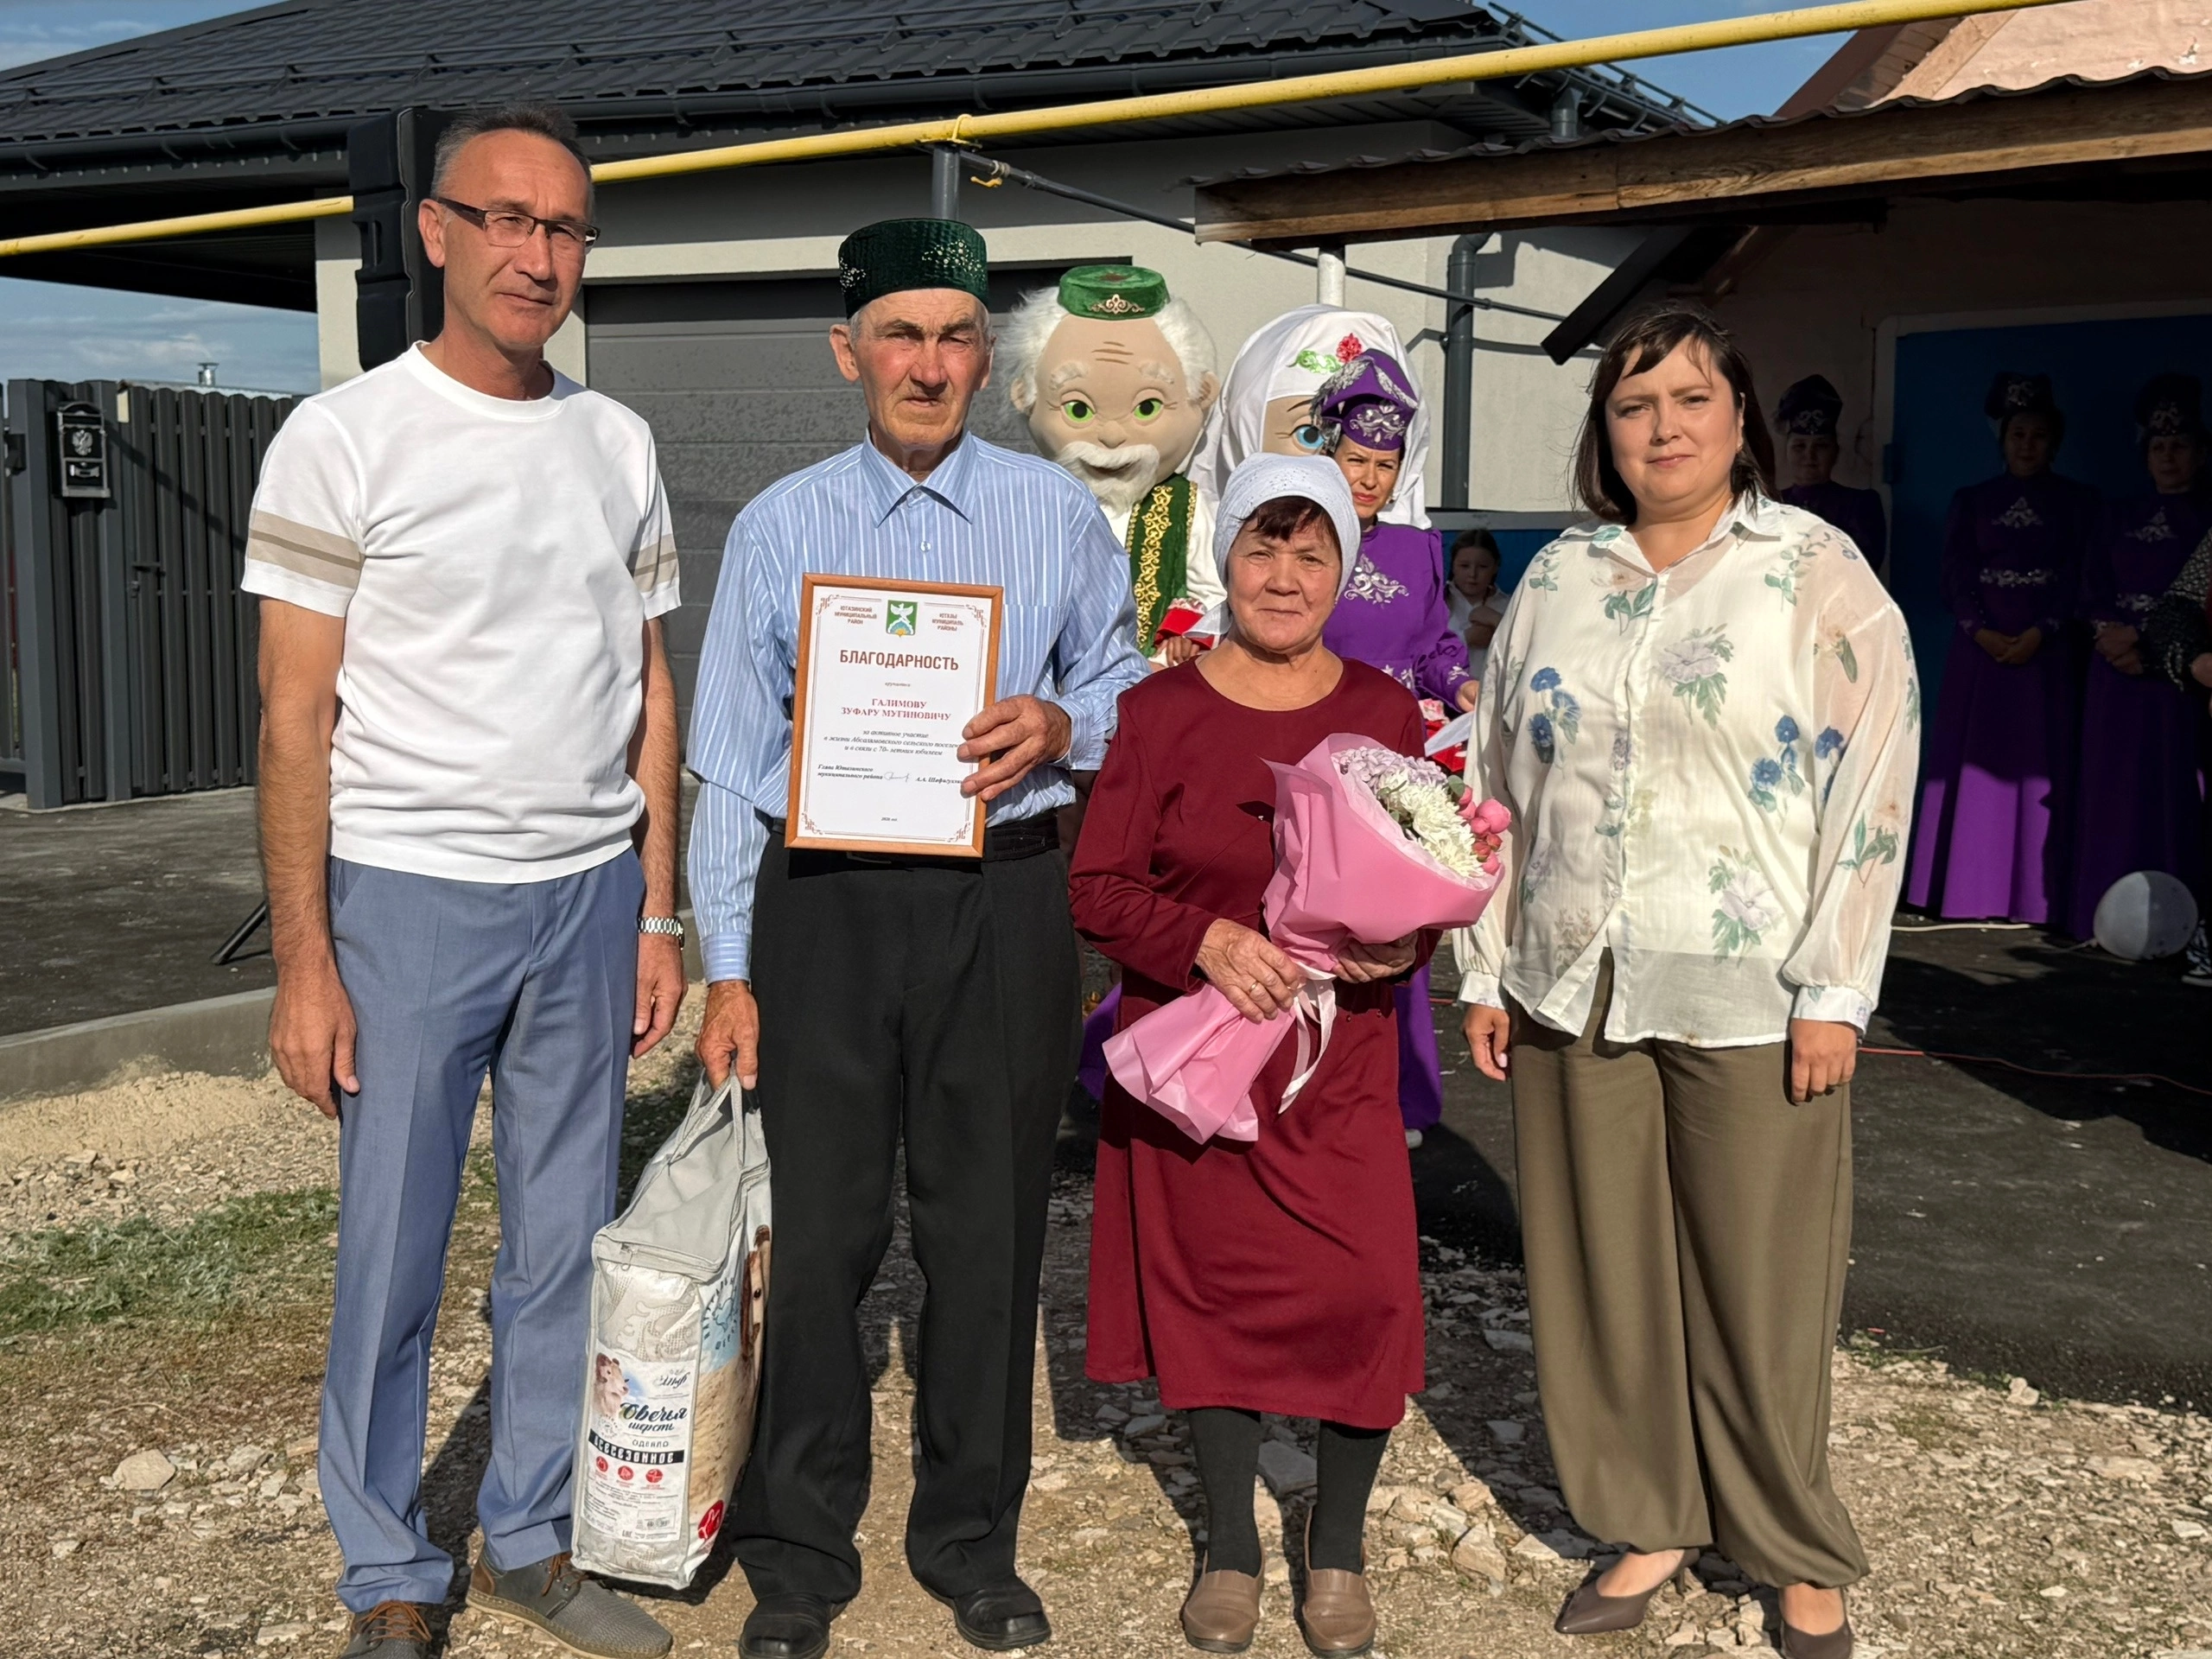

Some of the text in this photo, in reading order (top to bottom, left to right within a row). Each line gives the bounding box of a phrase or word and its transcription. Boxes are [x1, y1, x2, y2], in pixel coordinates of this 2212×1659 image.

[840, 650, 959, 671] БЛАГОДАРНОСТЬ
[872, 698, 927, 709] ГАЛИМОВУ
[841, 707, 880, 716] ЗУФАРУ
